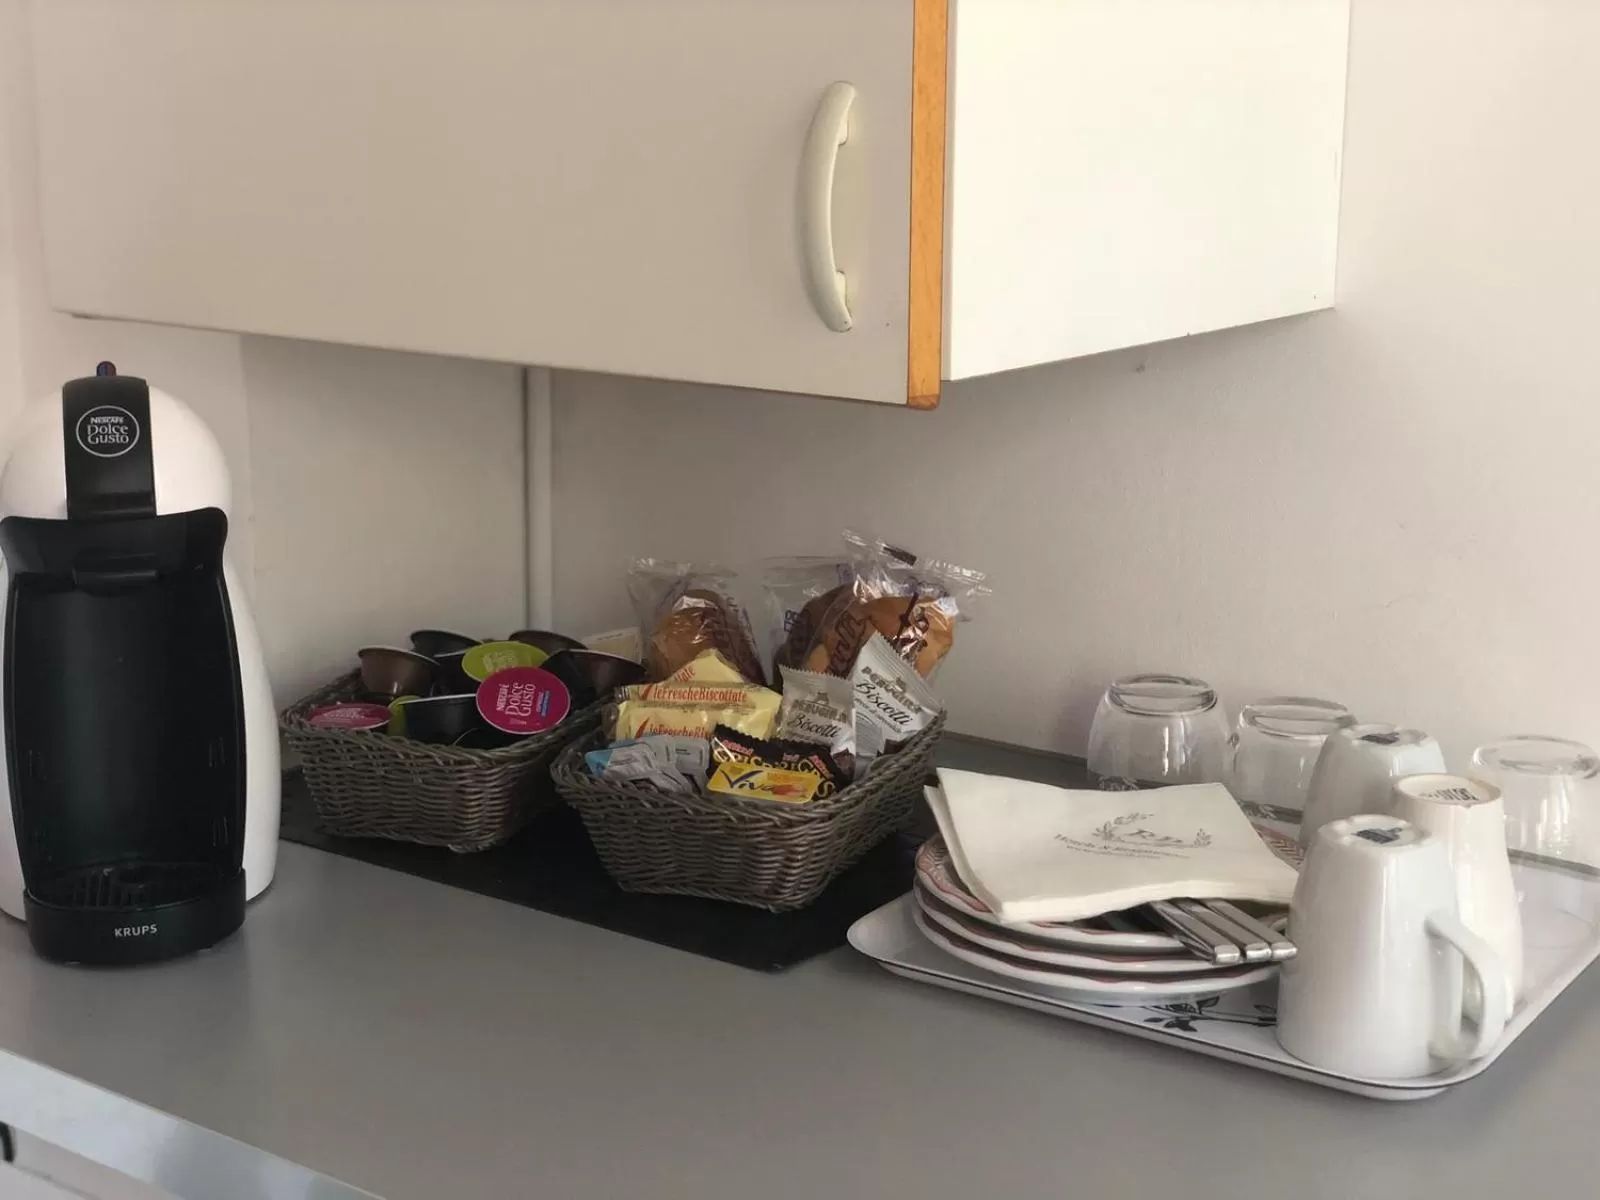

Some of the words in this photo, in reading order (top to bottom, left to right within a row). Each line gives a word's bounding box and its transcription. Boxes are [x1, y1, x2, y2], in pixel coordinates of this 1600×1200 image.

[87, 423, 129, 435] Dolce
[88, 433, 129, 445] Gusto
[505, 682, 524, 716] Dolce
[519, 683, 537, 717] Gusto
[855, 681, 915, 726] Biscotti
[786, 711, 843, 739] Biscotti
[114, 924, 157, 937] KRUPS
